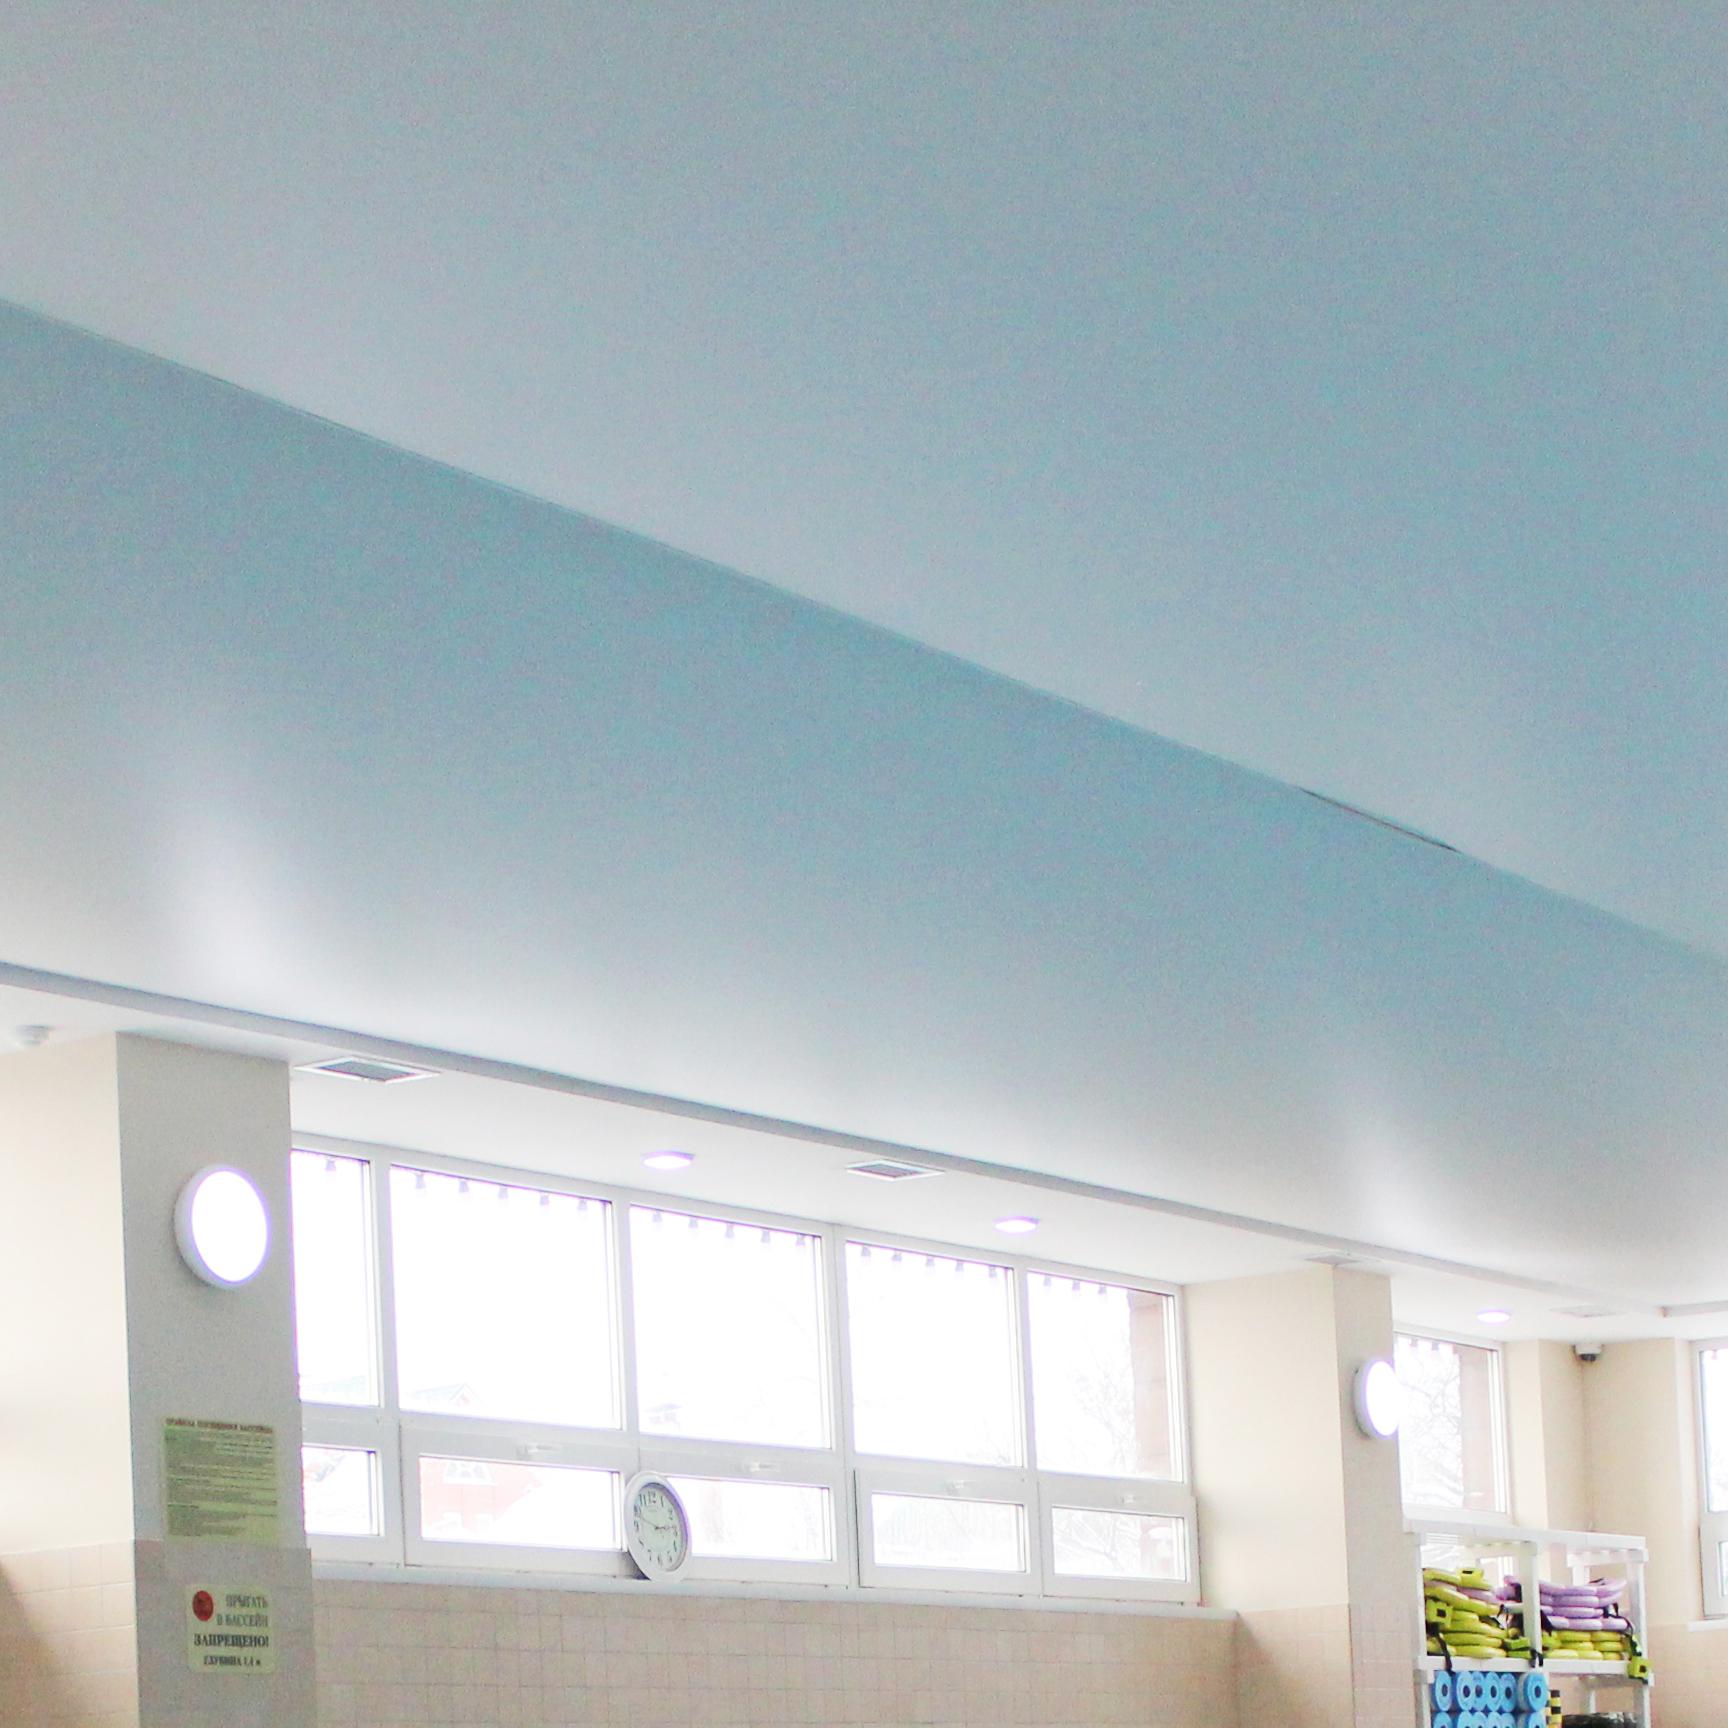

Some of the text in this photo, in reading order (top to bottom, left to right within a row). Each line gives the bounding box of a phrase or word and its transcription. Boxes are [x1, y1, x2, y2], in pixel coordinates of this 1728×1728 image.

[226, 1594, 268, 1608] ПРЫГАТЬ
[225, 1613, 268, 1627] БАССЕЙН
[194, 1633, 269, 1648] ЗАПРЕЩЕНО!
[203, 1655, 242, 1666] ГЛУБИНА
